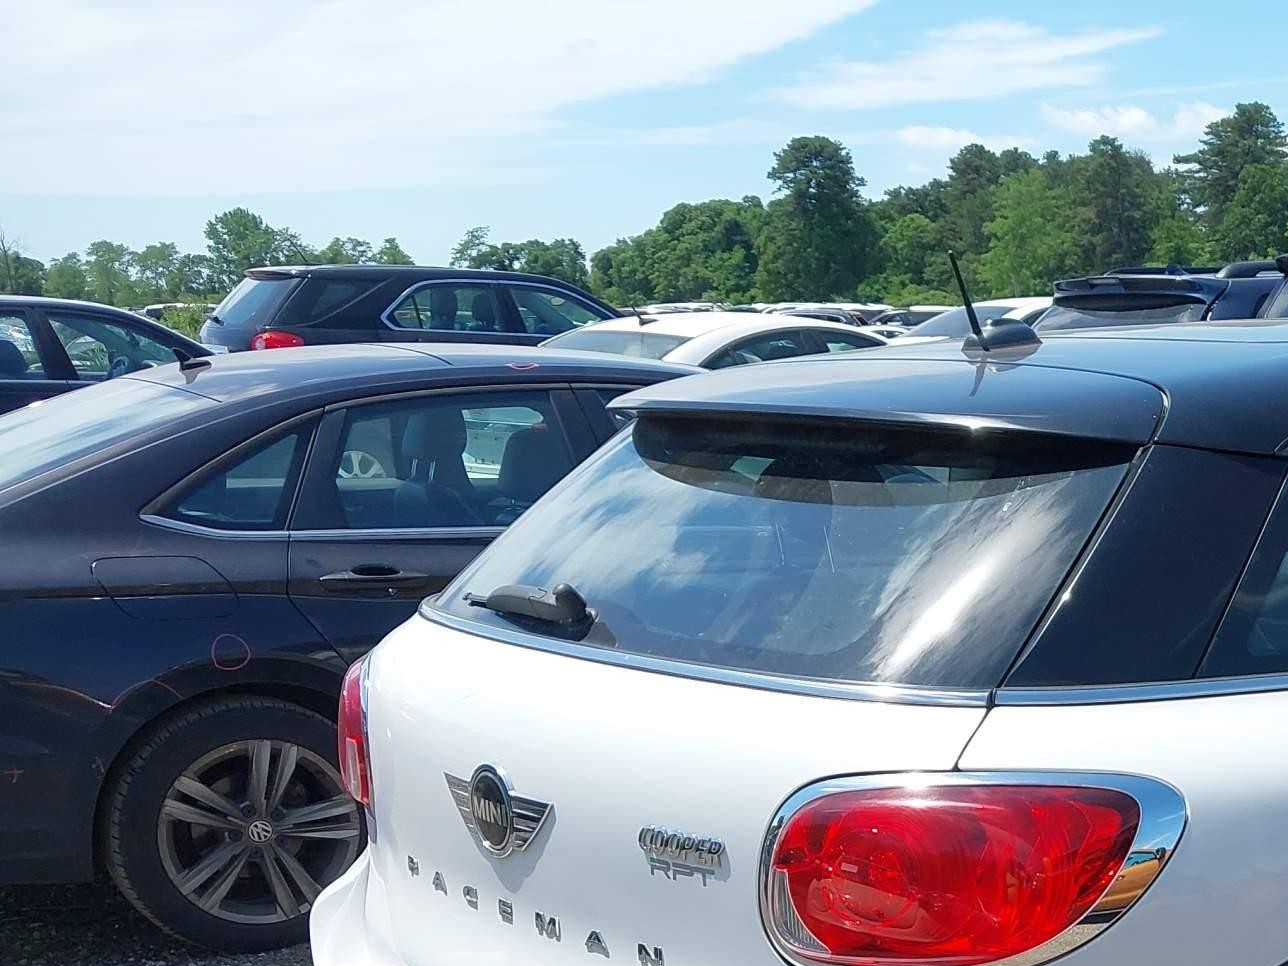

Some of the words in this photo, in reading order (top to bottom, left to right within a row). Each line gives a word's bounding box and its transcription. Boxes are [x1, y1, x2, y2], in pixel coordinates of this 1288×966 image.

[473, 795, 509, 829] MINI
[638, 825, 724, 866] COOPER
[649, 856, 716, 888] RPT
